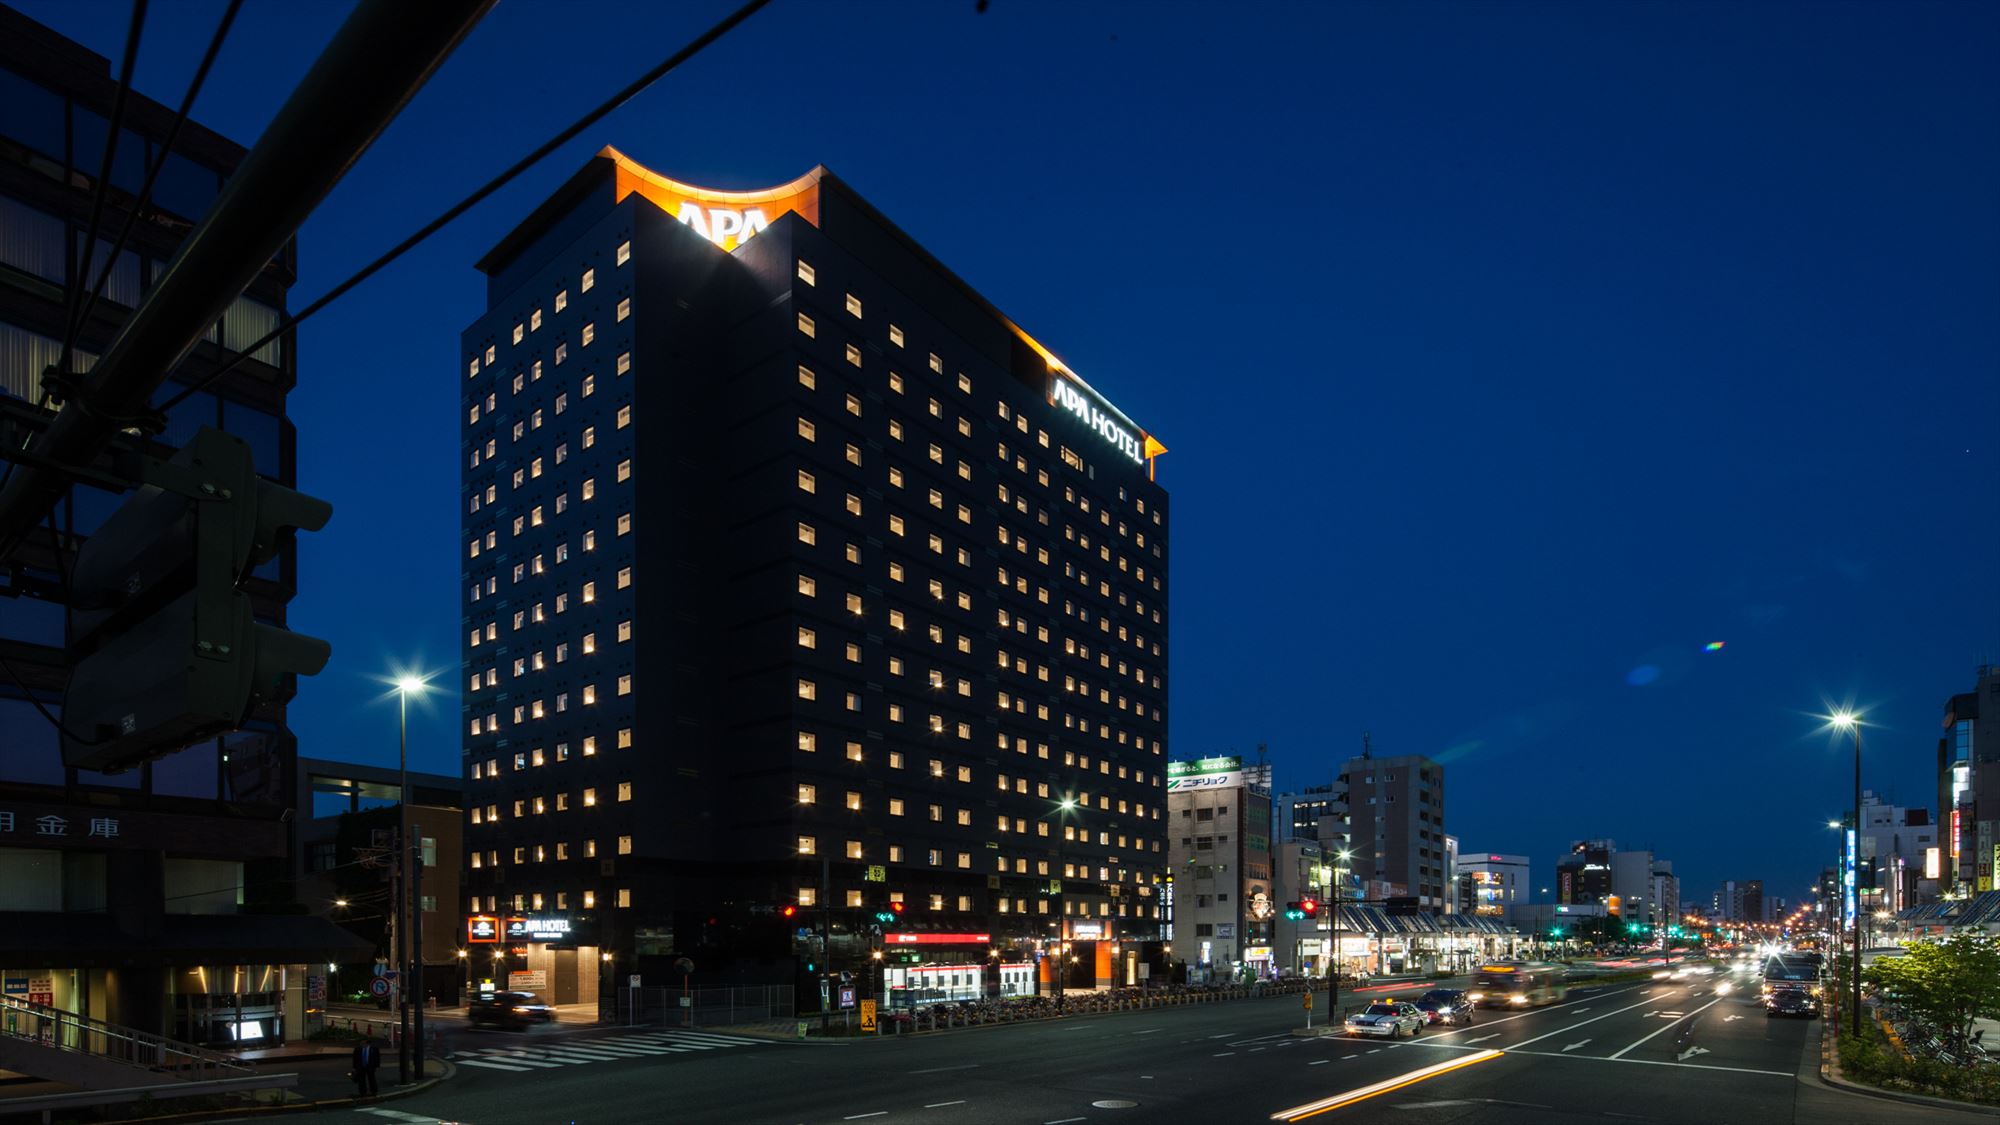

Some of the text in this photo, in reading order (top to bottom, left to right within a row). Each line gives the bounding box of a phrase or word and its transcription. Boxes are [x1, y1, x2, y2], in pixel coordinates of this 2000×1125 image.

[678, 200, 768, 244] APA
[1054, 379, 1143, 464] APA HOTEL
[1182, 775, 1228, 788] ニチリョク
[525, 919, 571, 932] APA HOTEL
